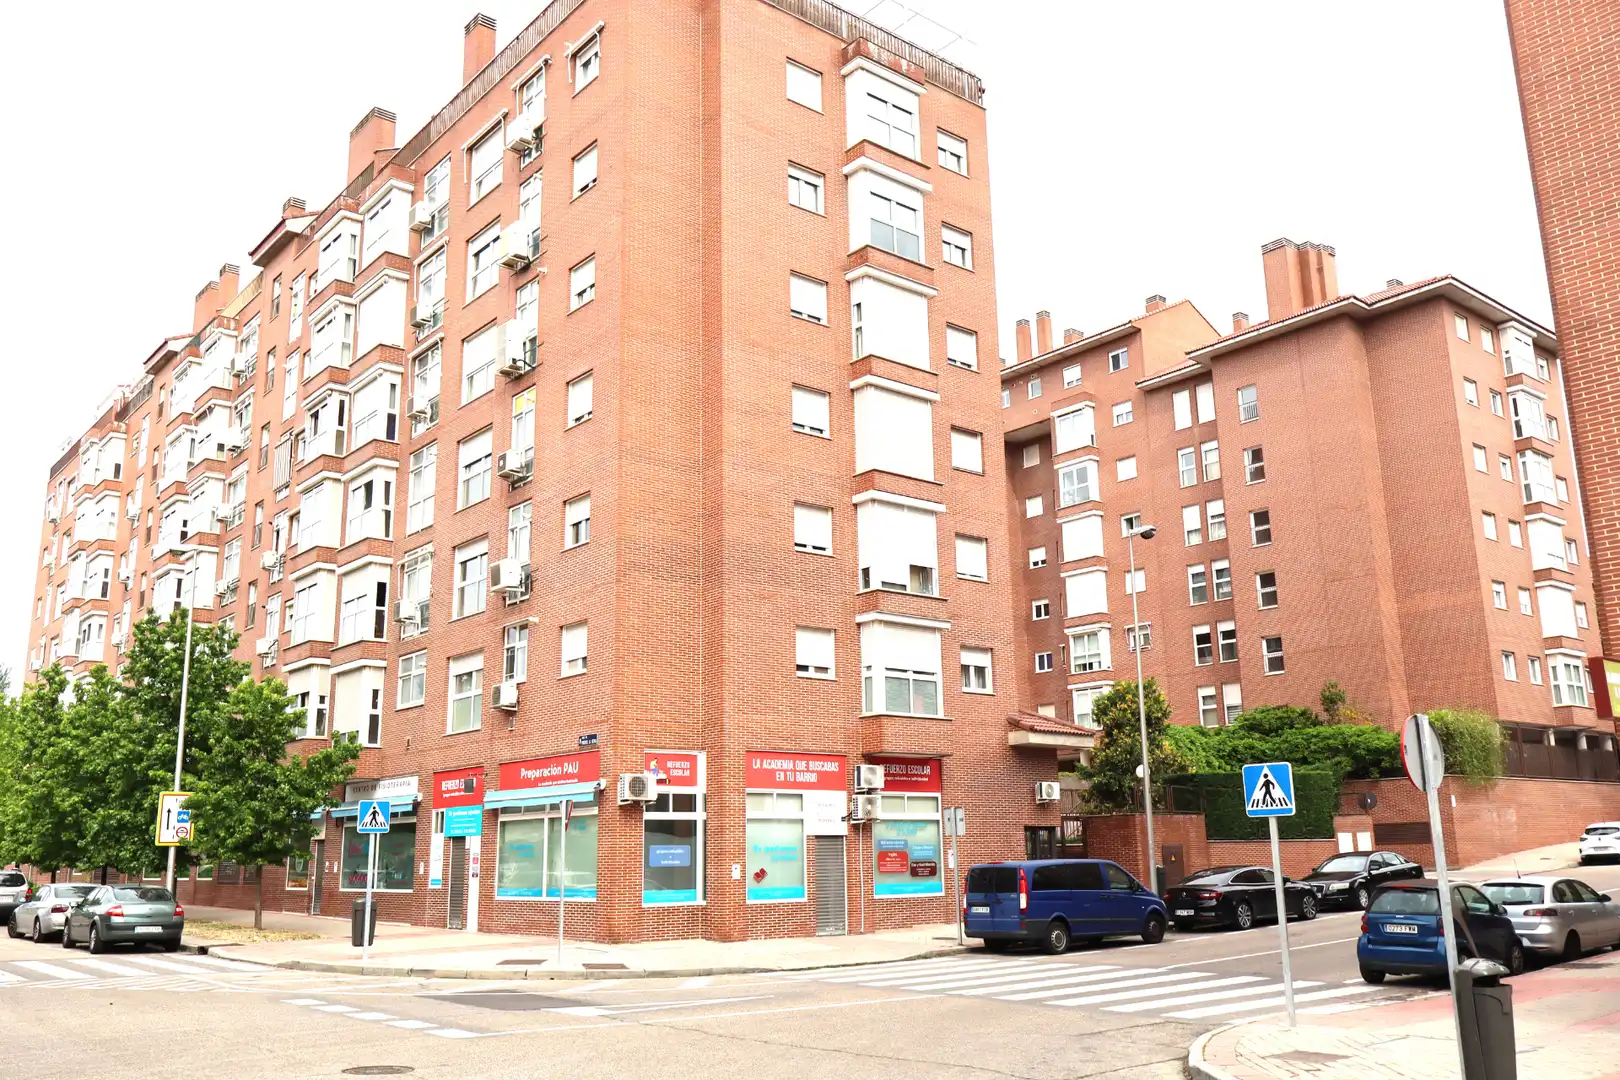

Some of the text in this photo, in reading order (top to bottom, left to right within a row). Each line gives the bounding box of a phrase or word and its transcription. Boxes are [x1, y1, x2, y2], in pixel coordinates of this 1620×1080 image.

[520, 761, 579, 781] Preparación PAU
[666, 761, 690, 769] REFUERZO
[752, 758, 839, 772] LA ACADEMIA QUE BUSCABAS
[907, 765, 931, 775] ESCOLAR
[776, 771, 817, 783] EN TU BARRIO
